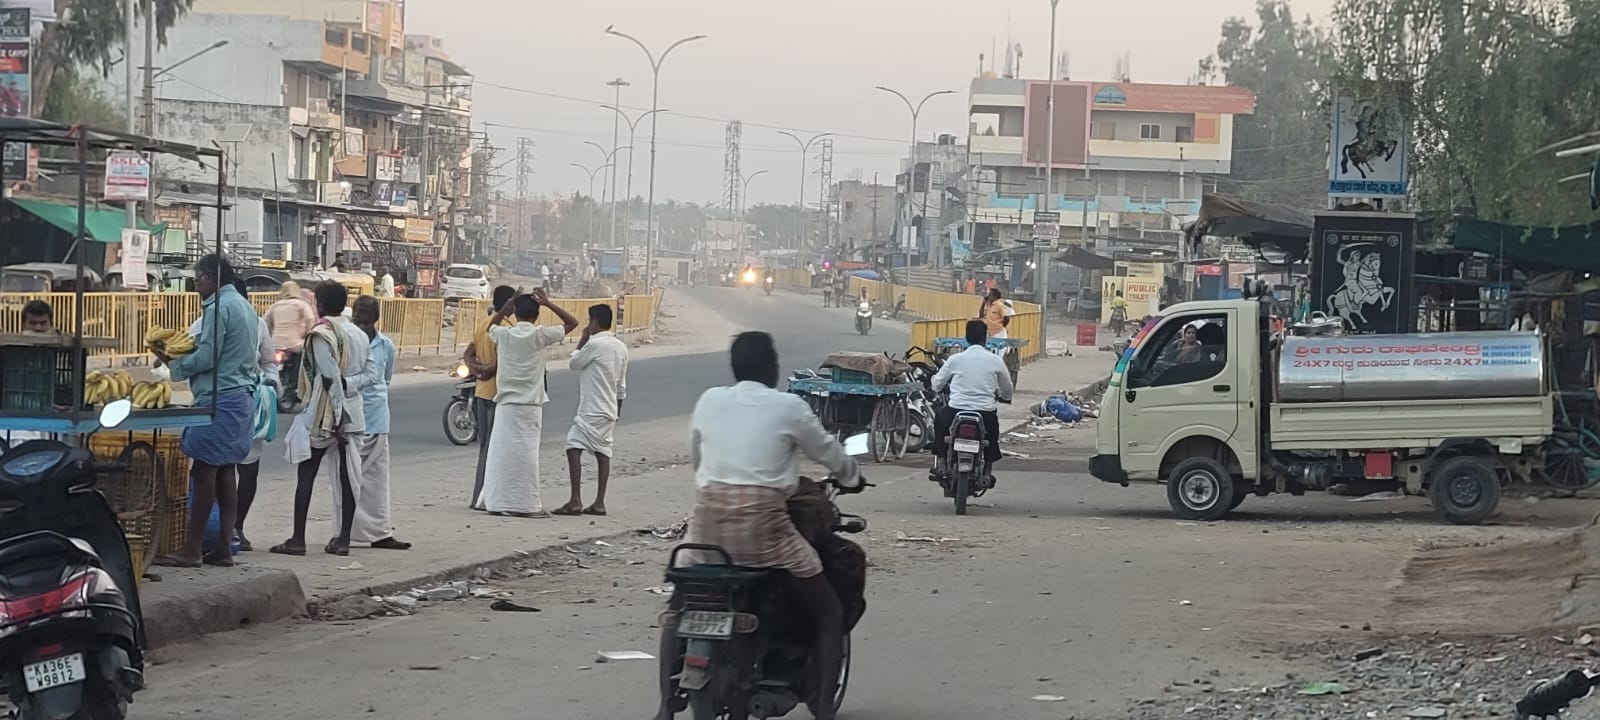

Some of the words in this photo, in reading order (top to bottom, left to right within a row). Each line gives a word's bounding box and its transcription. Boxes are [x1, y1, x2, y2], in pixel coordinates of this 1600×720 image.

[111, 158, 146, 167] SSLC
[1128, 284, 1156, 292] PUBLIC
[1295, 344, 1321, 358] ಶ್ರೀ
[1326, 345, 1374, 354] ಗುರು
[1379, 344, 1482, 356] ರಾಘವೇಂದ್ರ
[1357, 359, 1410, 368] ಕುಡಿಯುವ
[1413, 358, 1443, 367] ನೀರು
[1443, 358, 1482, 366] 24X7
[34, 657, 72, 675] KA36E
[37, 669, 74, 688] W9812
